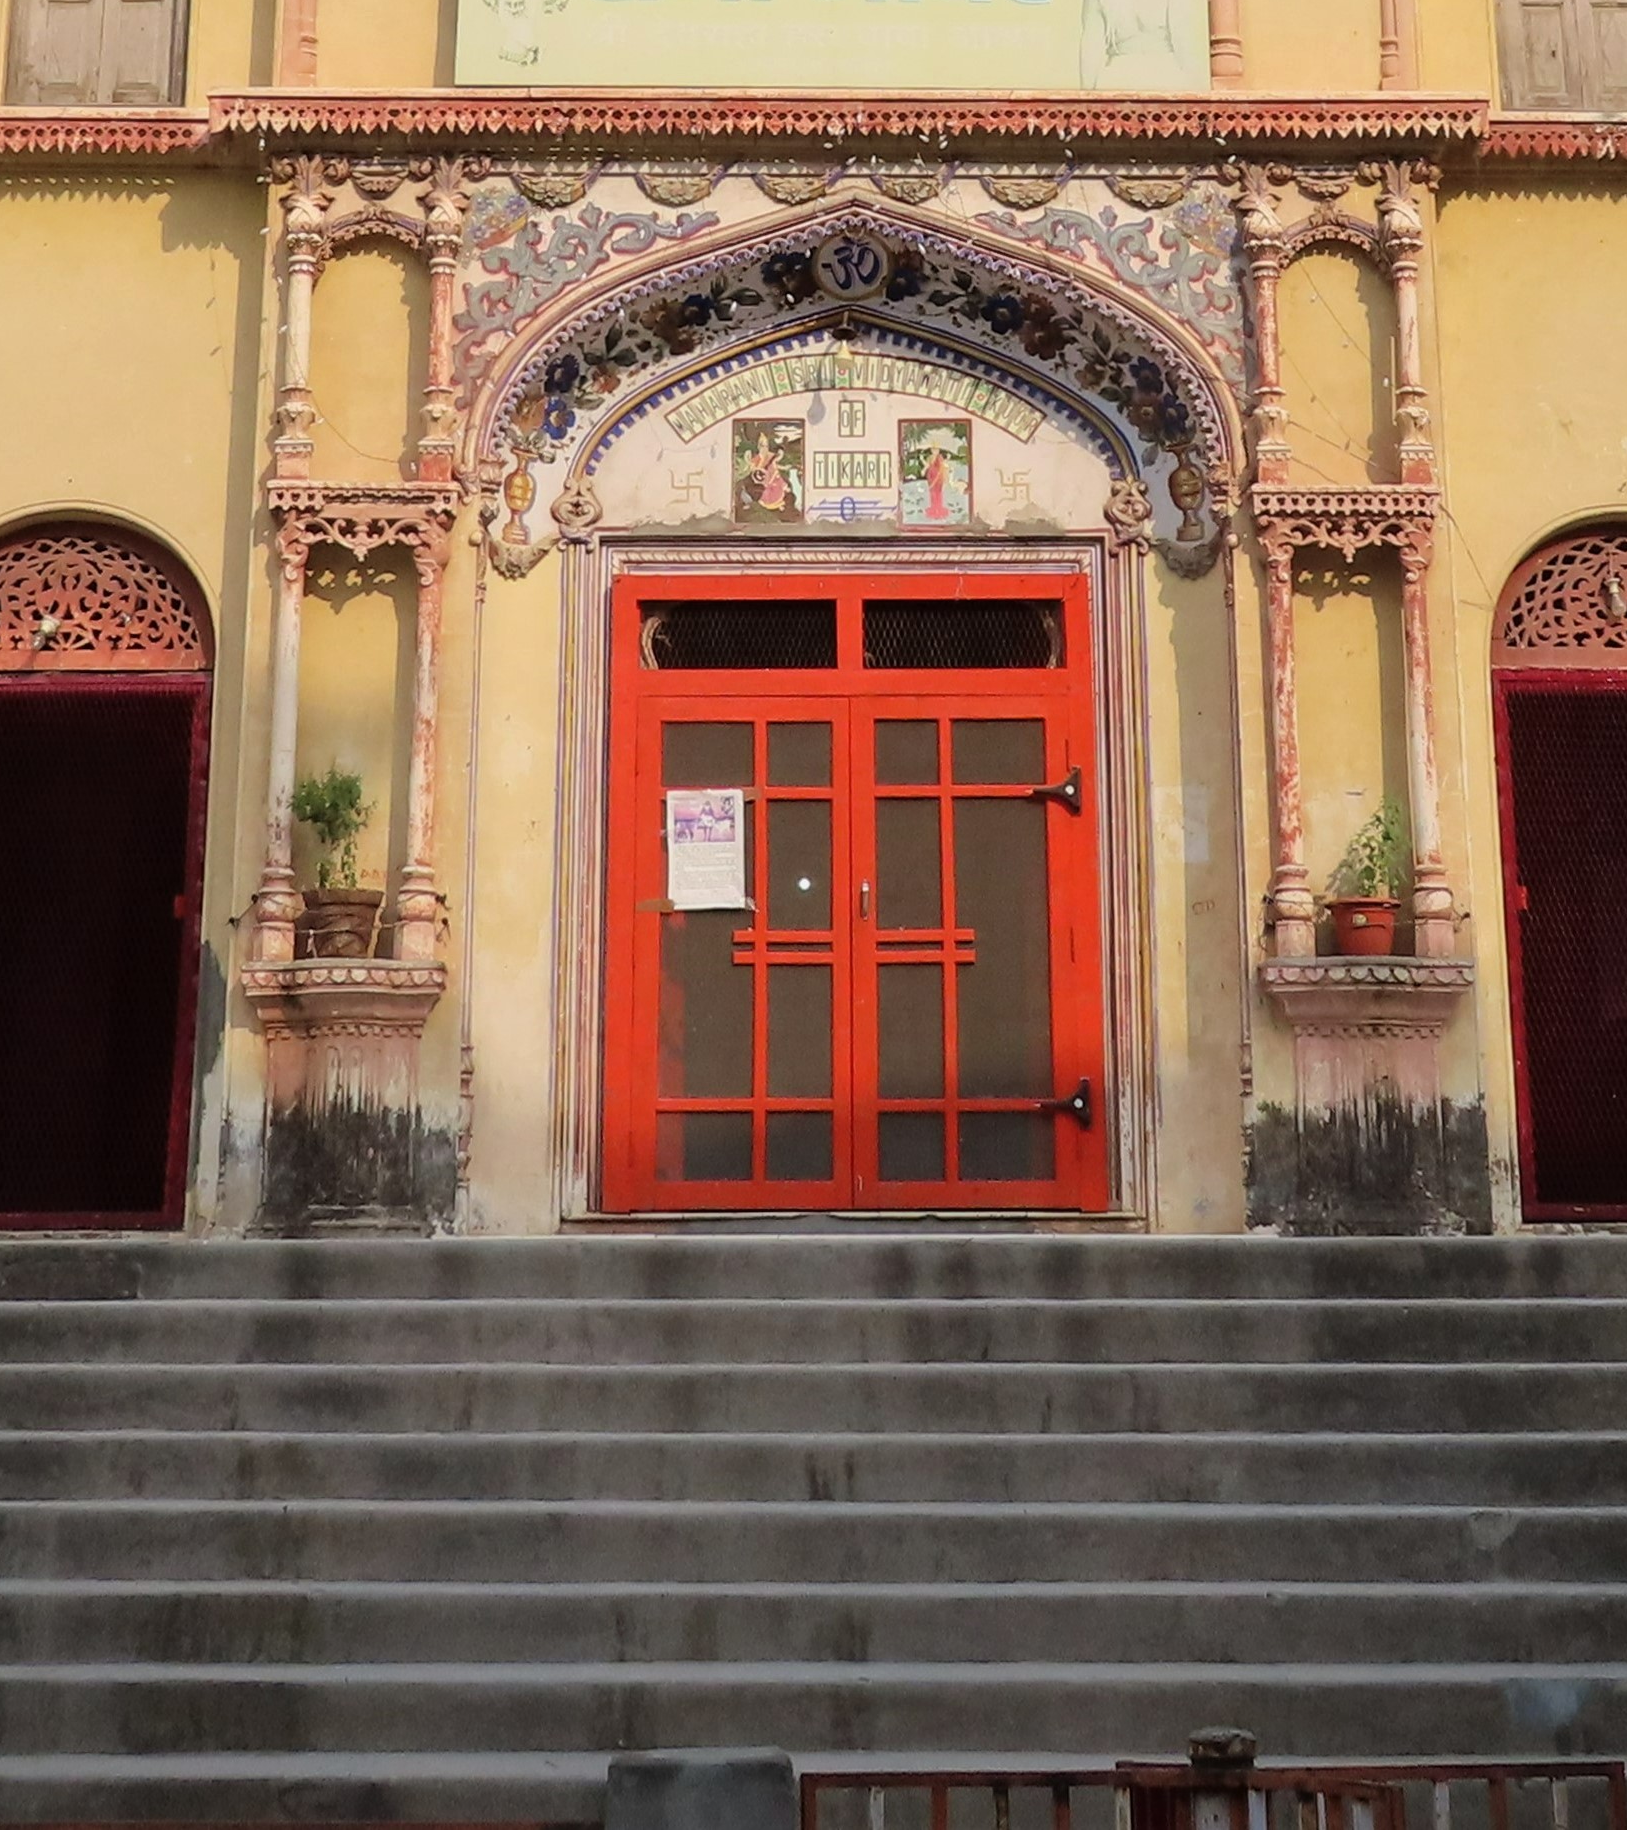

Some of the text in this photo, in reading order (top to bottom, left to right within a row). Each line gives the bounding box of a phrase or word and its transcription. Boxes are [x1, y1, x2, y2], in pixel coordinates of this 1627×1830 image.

[671, 368, 772, 432] MAHARANI
[793, 360, 833, 385] SRI
[841, 409, 862, 428] OF
[815, 460, 887, 480] TIKARI
